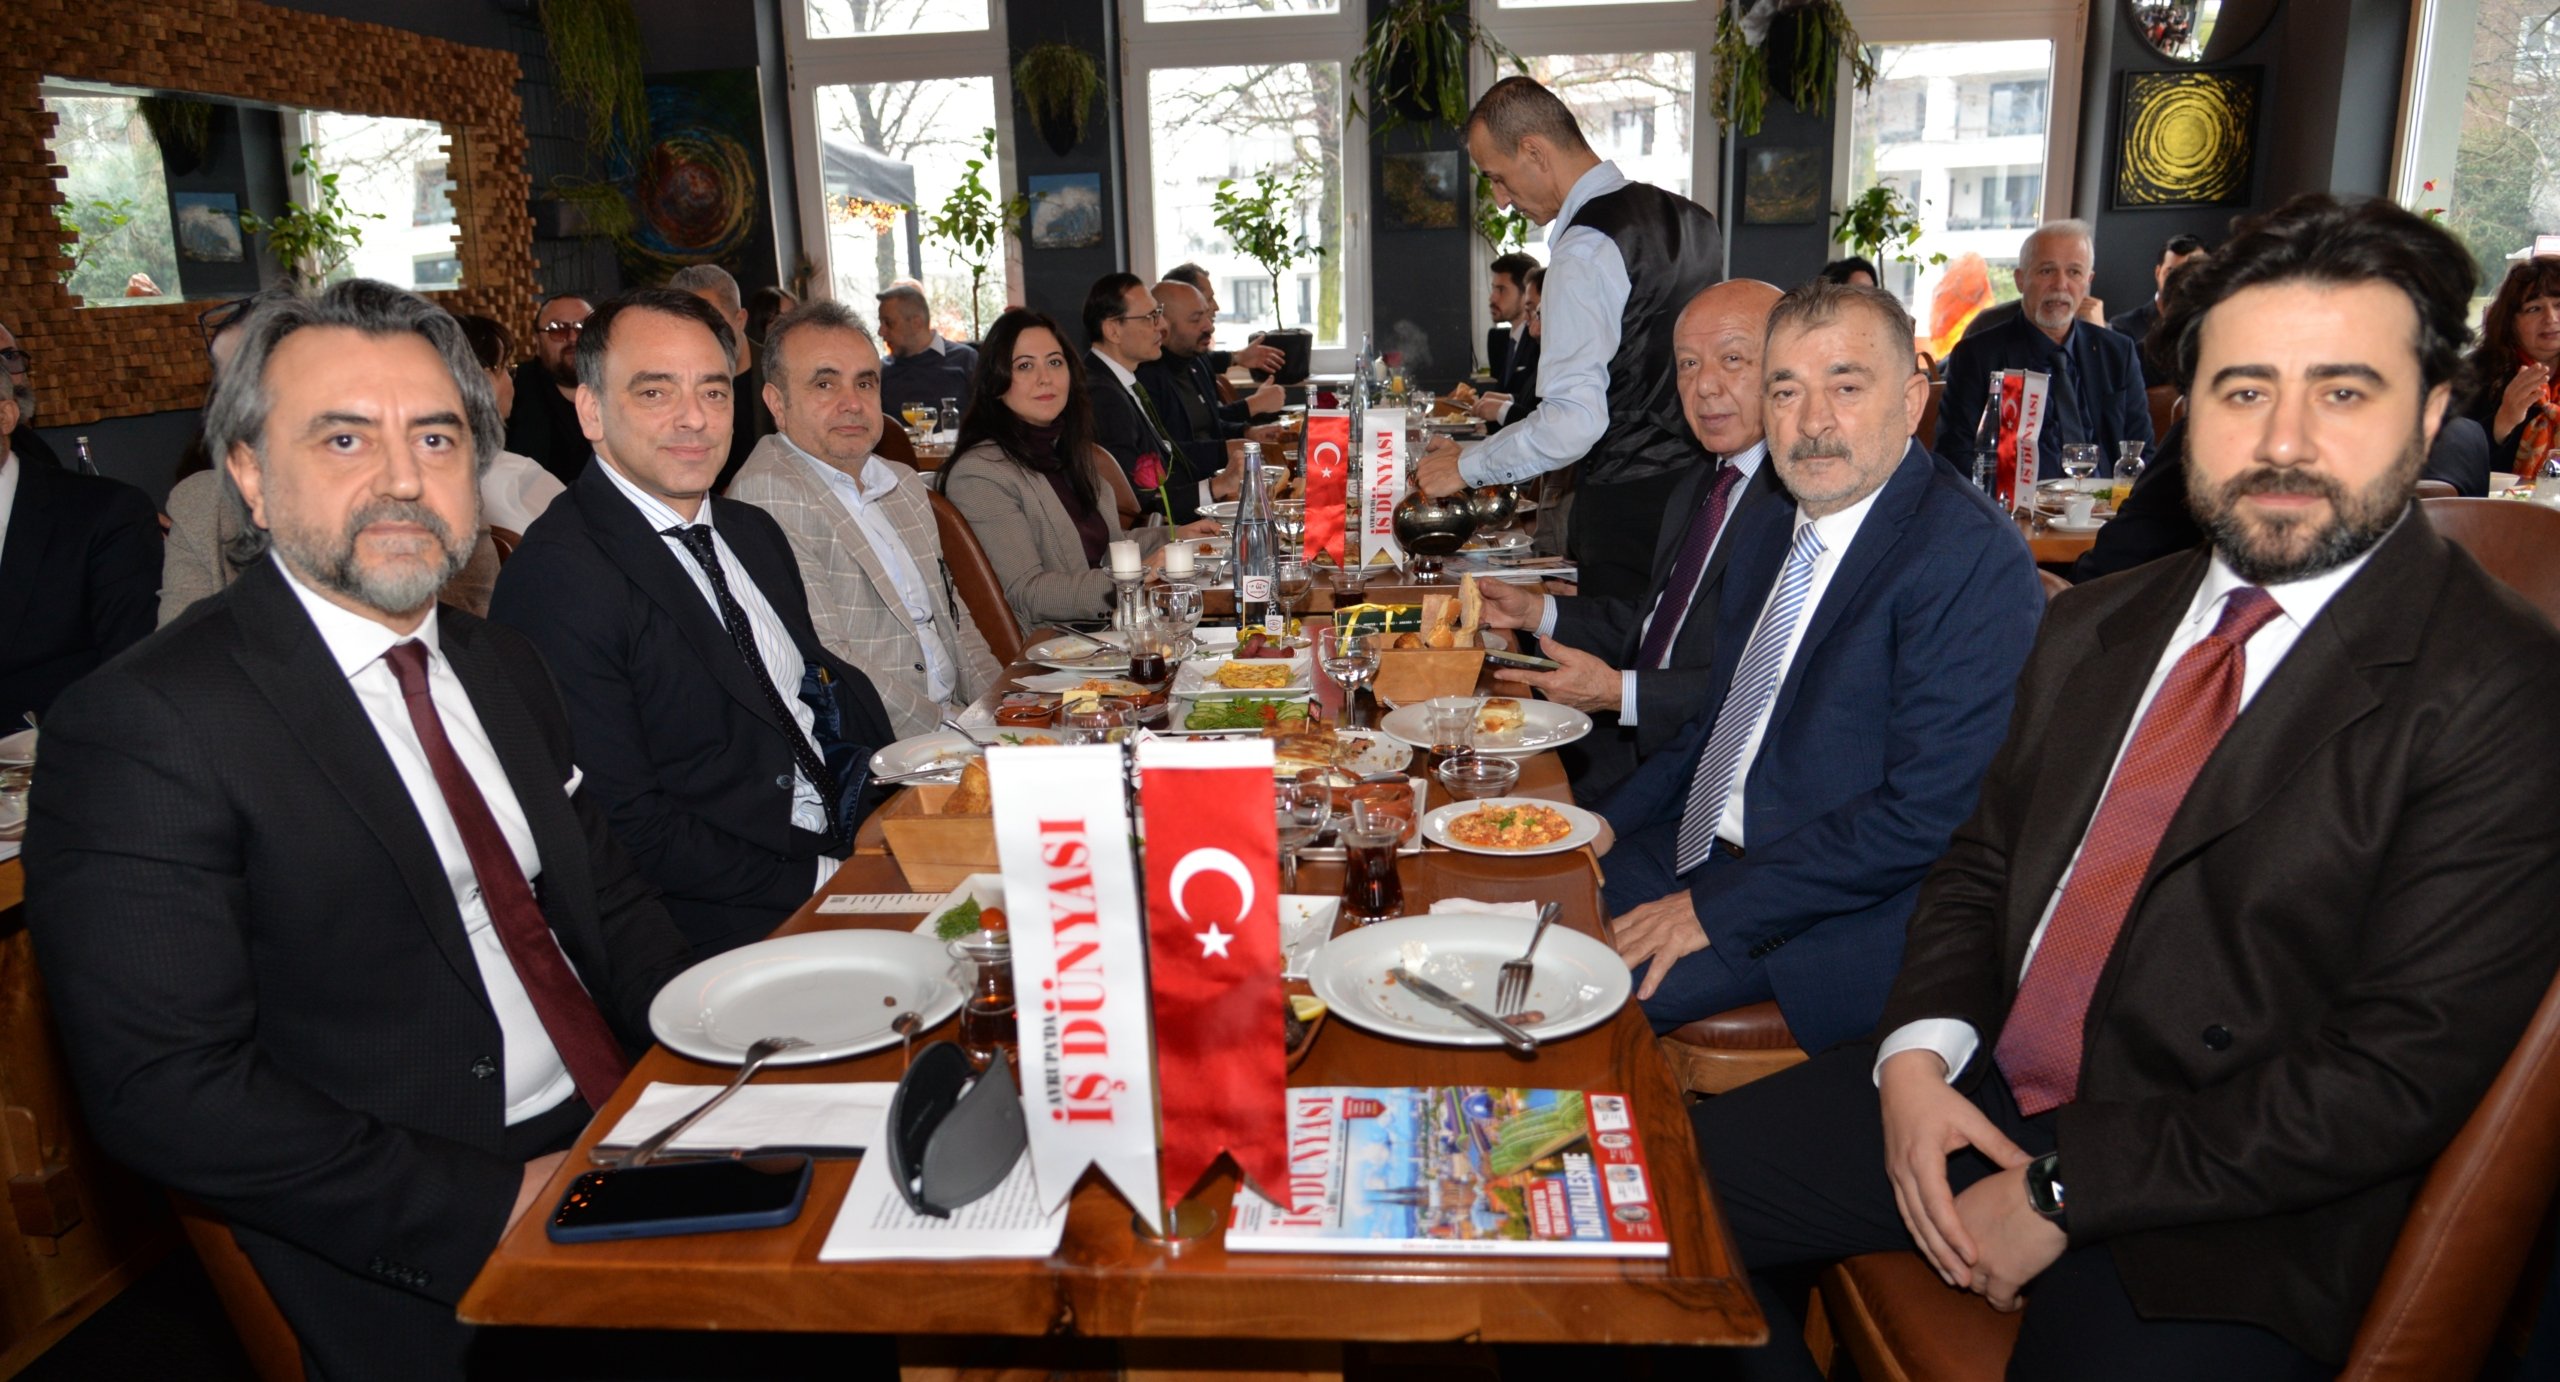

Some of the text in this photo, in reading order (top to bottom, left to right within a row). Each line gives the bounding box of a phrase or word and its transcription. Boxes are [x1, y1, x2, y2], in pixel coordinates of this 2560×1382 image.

[1372, 431, 1393, 512] DÜNYASI
[1038, 817, 1127, 1125] İŞ DÜNYASI
[1041, 1015, 1063, 1107] AVRUPA'DA
